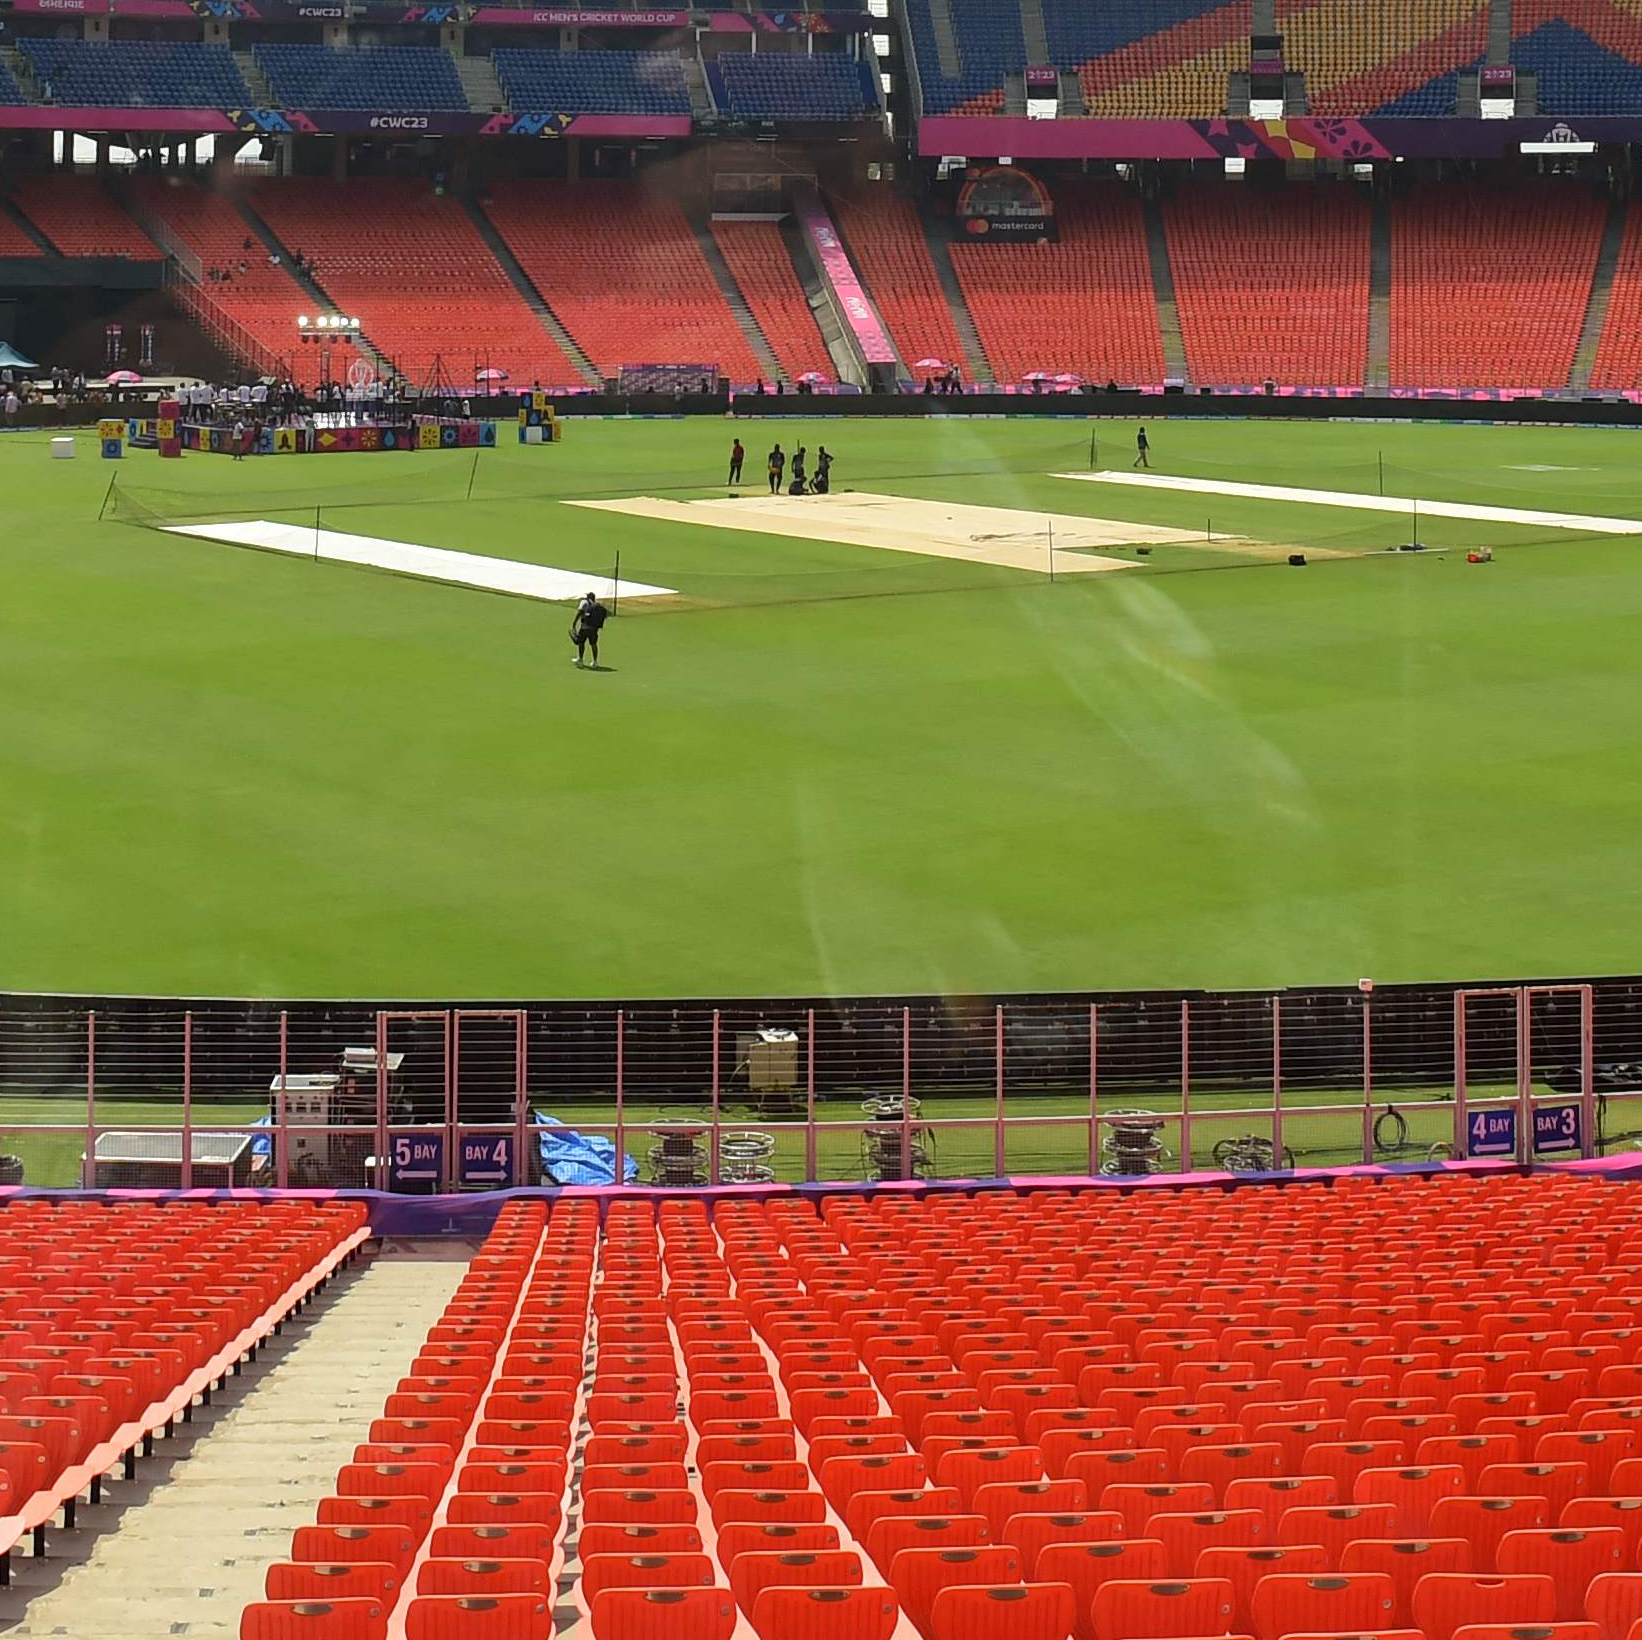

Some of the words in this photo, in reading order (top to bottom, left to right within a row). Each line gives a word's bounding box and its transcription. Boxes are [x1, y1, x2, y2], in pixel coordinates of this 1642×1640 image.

[370, 117, 428, 128] #CWC23
[992, 222, 1044, 230] mastercard
[1472, 1113, 1487, 1139] 4
[1489, 1118, 1510, 1132] BAY
[1537, 1116, 1558, 1131] BAY
[1561, 1108, 1575, 1134] 3
[396, 1138, 411, 1165] 5
[414, 1144, 437, 1159] BAY
[465, 1145, 488, 1160] BAY
[492, 1139, 507, 1166] 4
